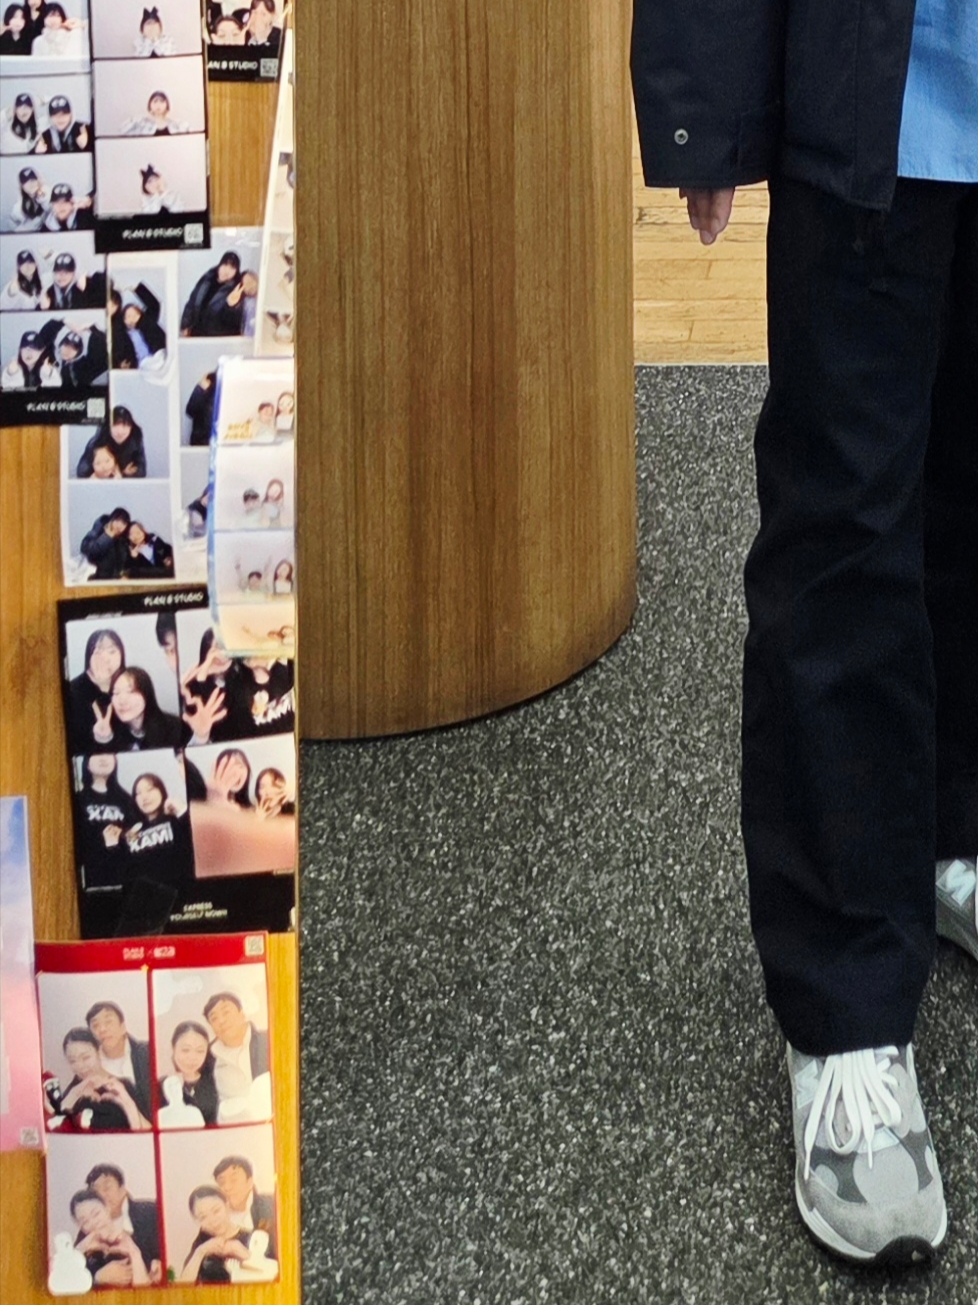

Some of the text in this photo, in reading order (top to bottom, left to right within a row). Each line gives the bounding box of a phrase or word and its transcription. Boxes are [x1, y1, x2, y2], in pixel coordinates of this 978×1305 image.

[228, 59, 258, 71] STUDIO
[153, 226, 184, 239] STUDIO
[57, 400, 86, 412] STUDIO
[174, 591, 205, 604] STUDIO
